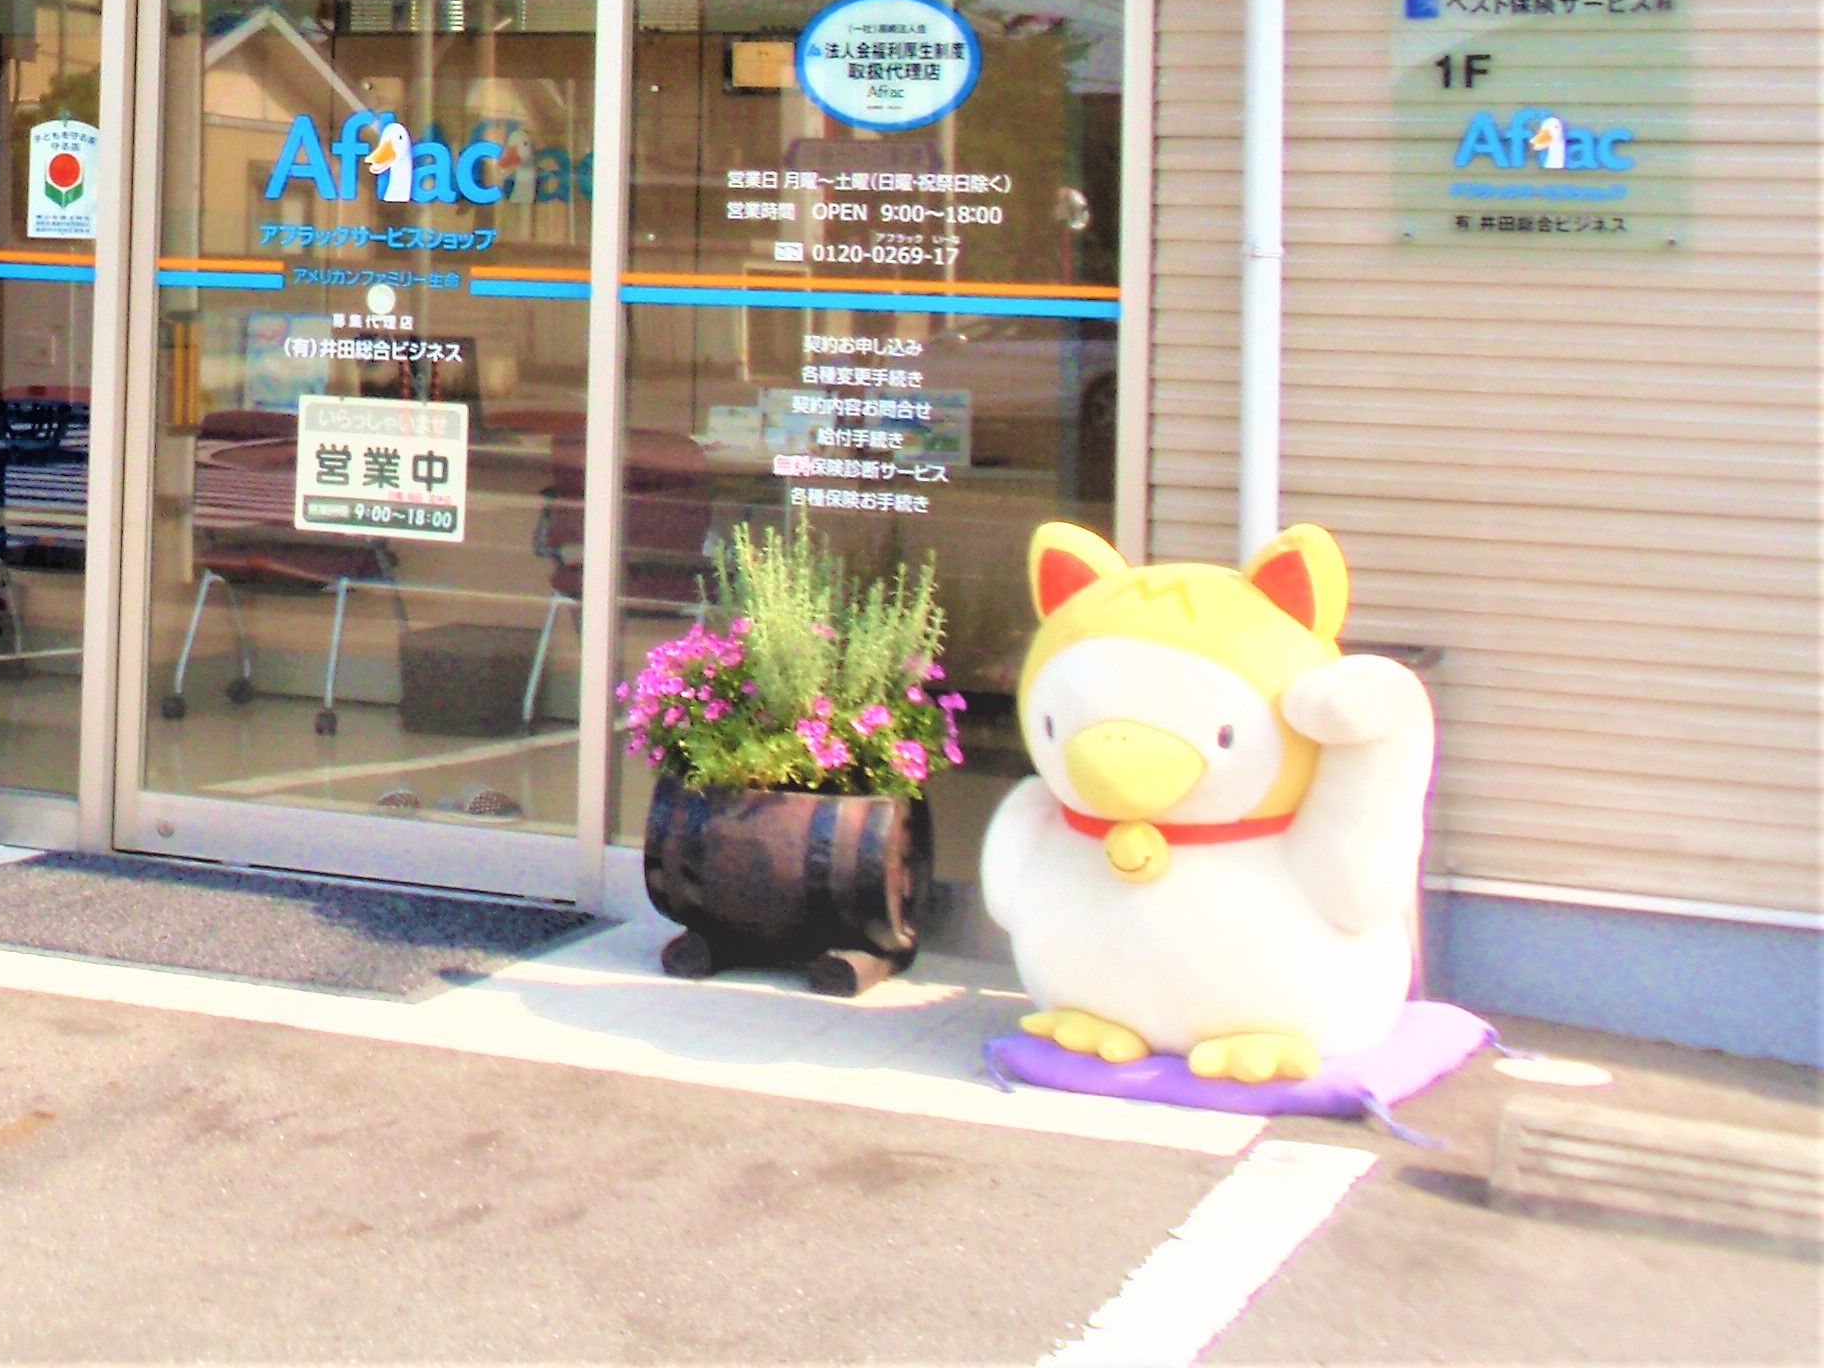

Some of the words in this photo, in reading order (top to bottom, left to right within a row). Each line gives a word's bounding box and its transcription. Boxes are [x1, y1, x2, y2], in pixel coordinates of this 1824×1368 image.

[847, 62, 941, 81] 取扱代理店
[1433, 53, 1493, 89] 1F
[1452, 105, 1636, 171] Aflac
[264, 109, 504, 205] Aflac
[726, 170, 779, 190] 営業日
[726, 201, 795, 221] 営業時間
[812, 203, 868, 222] OPEN
[259, 223, 499, 251] アフラックサービスショップ
[812, 244, 960, 266] 0120-0269-17
[292, 267, 462, 290] アメリカンファミリー生命
[283, 337, 463, 362] (有)井田総合ビジネス
[803, 334, 924, 358] 契約お申し込み
[801, 365, 924, 389] 各種変更手続き
[791, 395, 933, 420] 契約内容お問合せ
[816, 428, 905, 450] 給付手続き
[315, 442, 450, 492] 営業中
[789, 487, 930, 514] 各種保険お手続き
